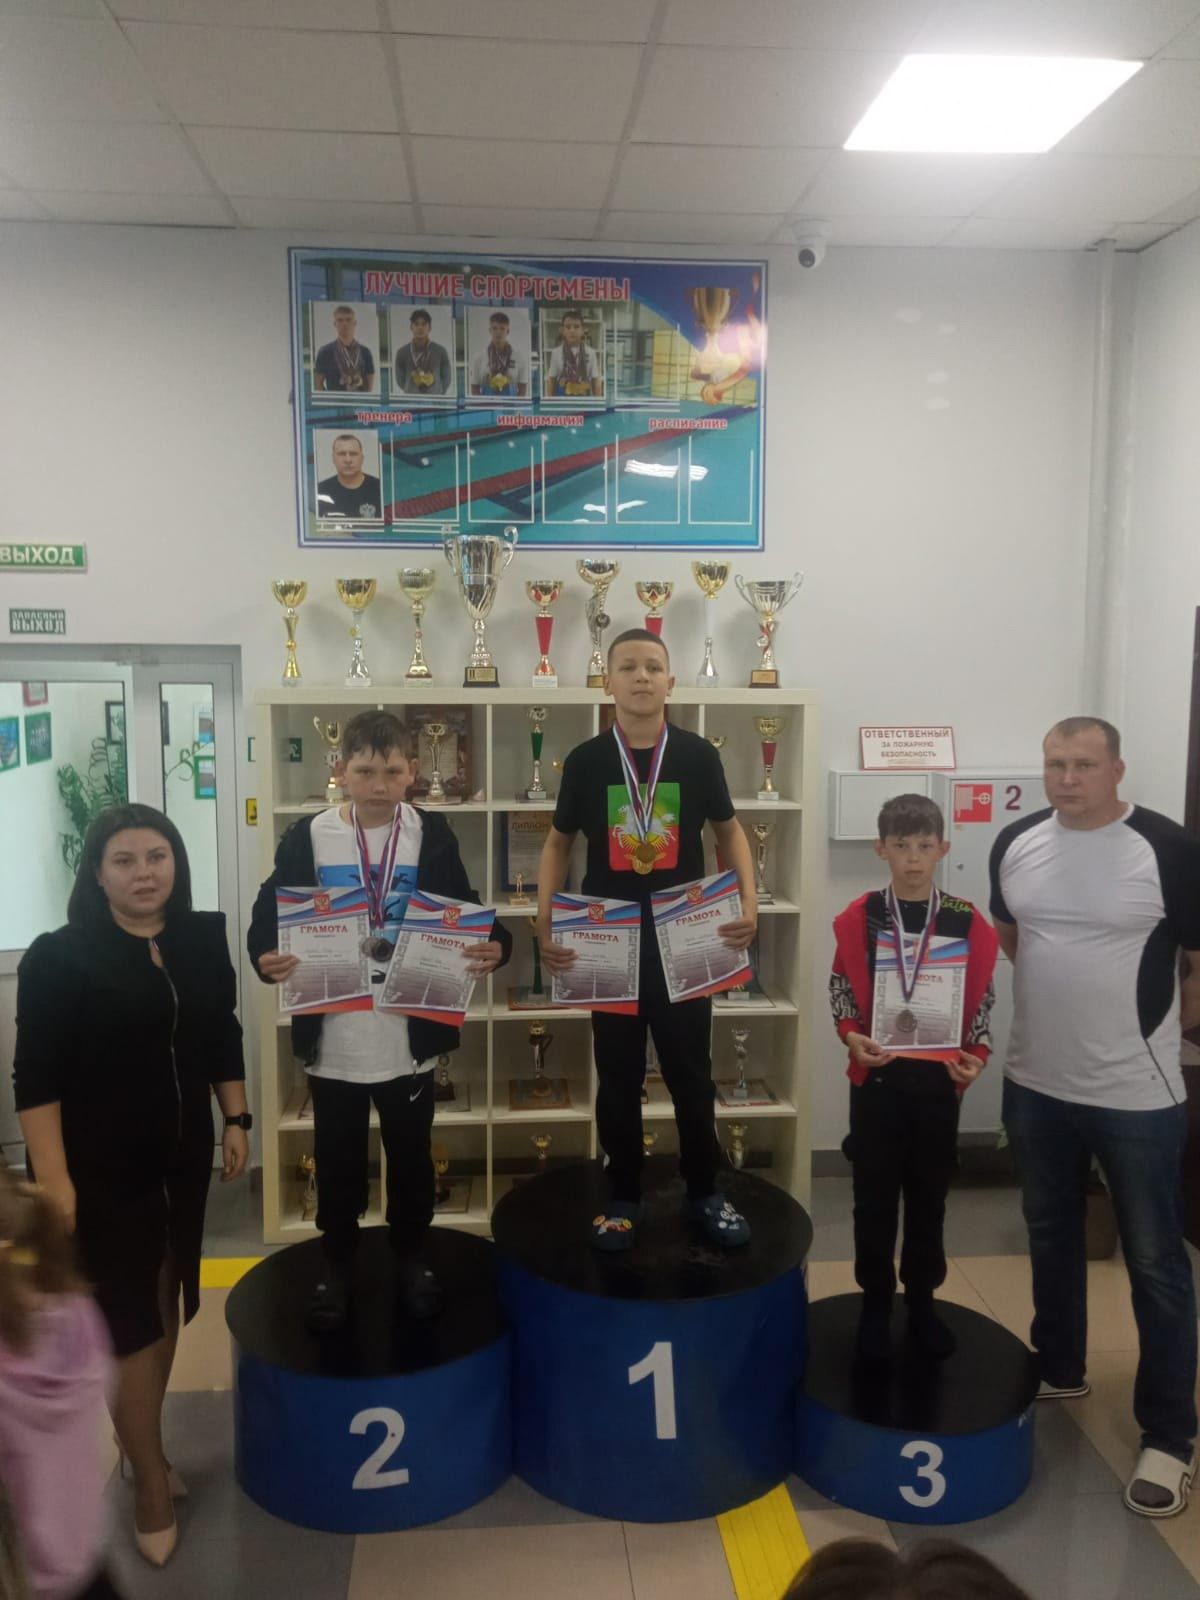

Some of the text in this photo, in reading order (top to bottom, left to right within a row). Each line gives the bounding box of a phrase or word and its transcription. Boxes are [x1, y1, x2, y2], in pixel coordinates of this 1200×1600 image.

[364, 271, 630, 301] ЛУЧШИЕ СПОРТСМЕНЫ
[357, 412, 412, 424] тренера
[497, 413, 584, 429] информация
[0, 546, 75, 565] ВЫХОД
[12, 619, 64, 632] ВЫХОД
[865, 729, 950, 738] ОТВЕТСТВЕННЫЙ
[1005, 785, 1022, 810] 2
[675, 909, 721, 926] ГРАМОТА
[300, 925, 348, 934] ГРАМОТА
[572, 932, 619, 943] ГРАМОТА
[420, 933, 466, 949] ГРАМОТА
[628, 1341, 677, 1440] 1
[349, 1407, 409, 1490] 2
[899, 1440, 947, 1508] 3
